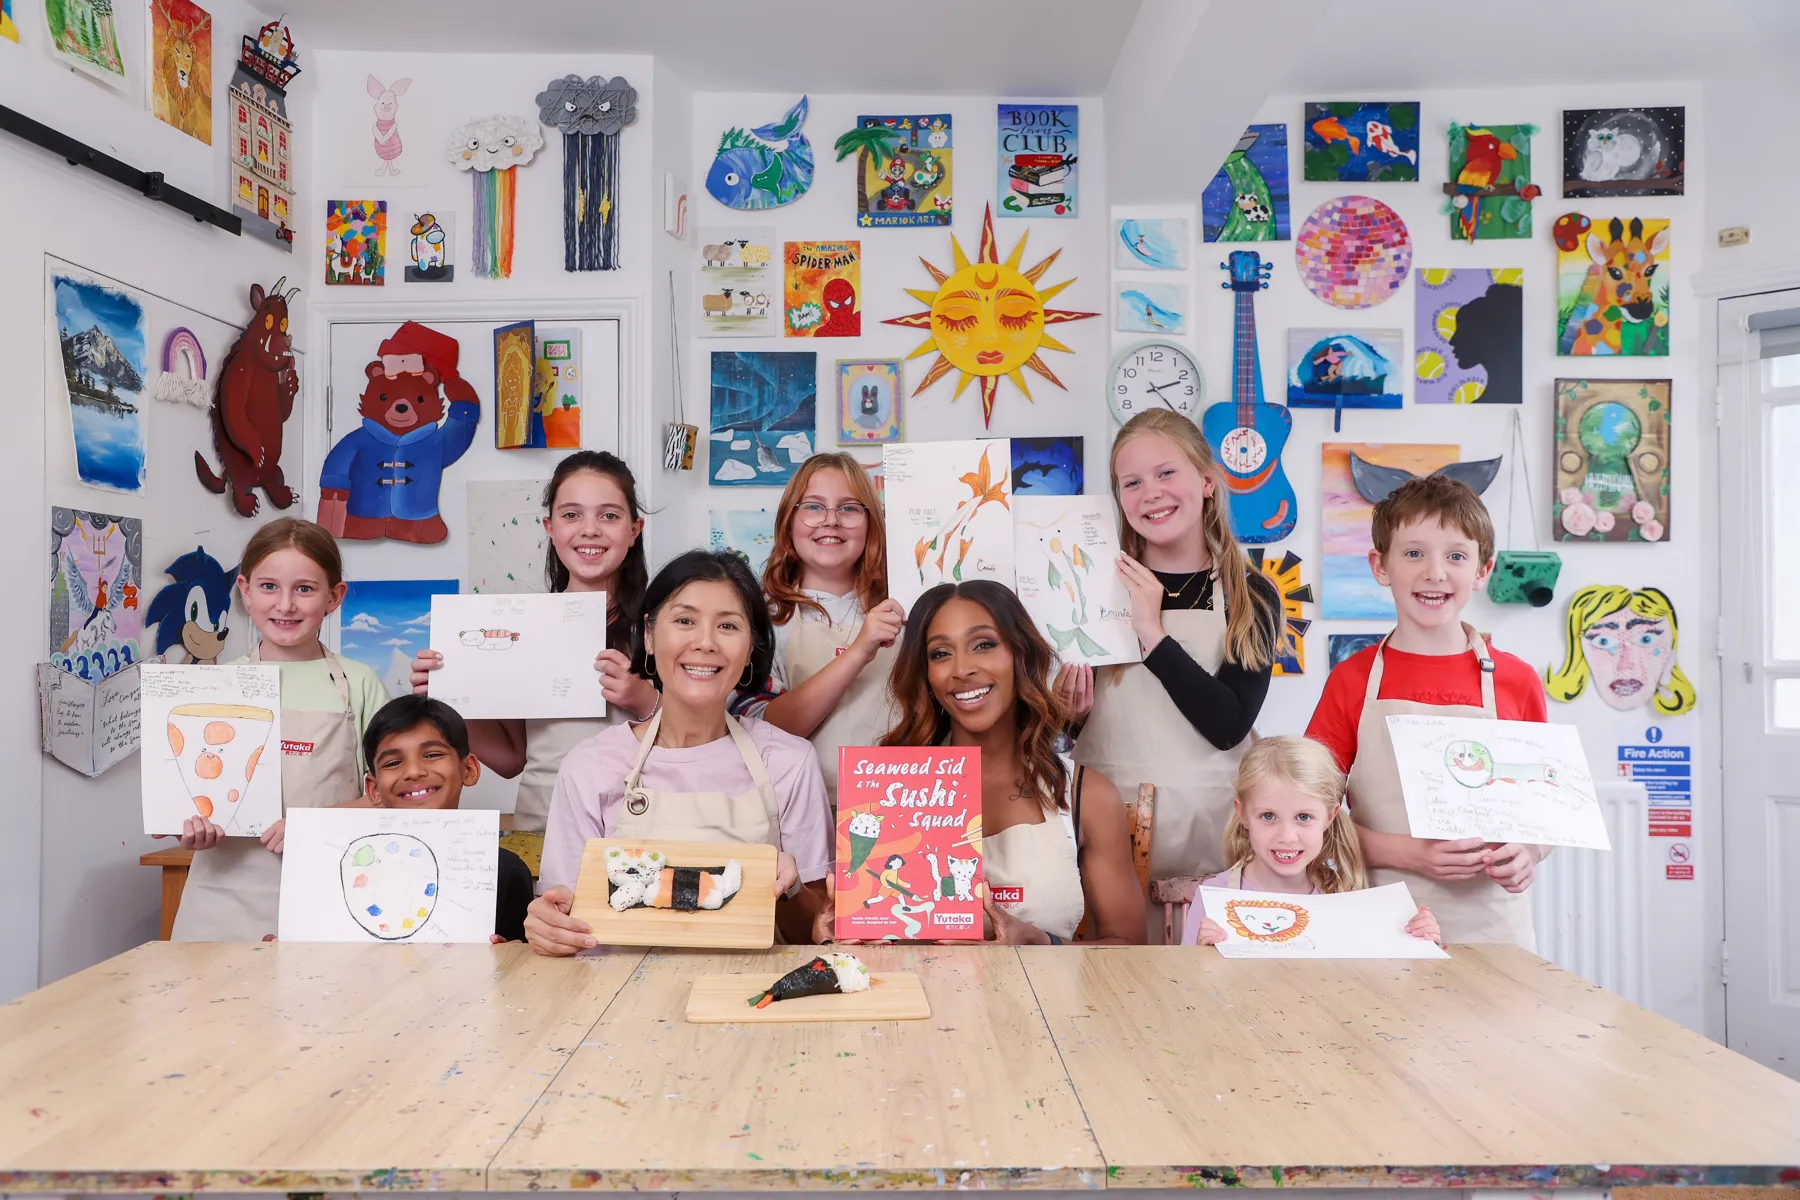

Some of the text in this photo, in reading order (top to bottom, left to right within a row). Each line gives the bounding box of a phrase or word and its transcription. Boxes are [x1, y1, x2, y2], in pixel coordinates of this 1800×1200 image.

[1008, 110, 1071, 128] BOOK
[1003, 134, 1067, 153] CLUB
[1136, 356, 1144, 366] 11
[1150, 352, 1163, 361] 12
[1173, 357, 1177, 367] 1
[1123, 368, 1137, 378] 10
[1178, 370, 1188, 380] 2
[1118, 385, 1128, 394] 9
[1184, 386, 1193, 395] 3
[1122, 400, 1132, 409] 8
[1178, 402, 1188, 410] 4
[1624, 748, 1684, 760] Fire Action
[853, 757, 966, 775] Seaweed Sid
[866, 780, 880, 788] The
[879, 778, 958, 808] Sushi
[908, 808, 968, 831] Squad
[991, 889, 1020, 900] taka
[936, 915, 971, 923] Yutaka
